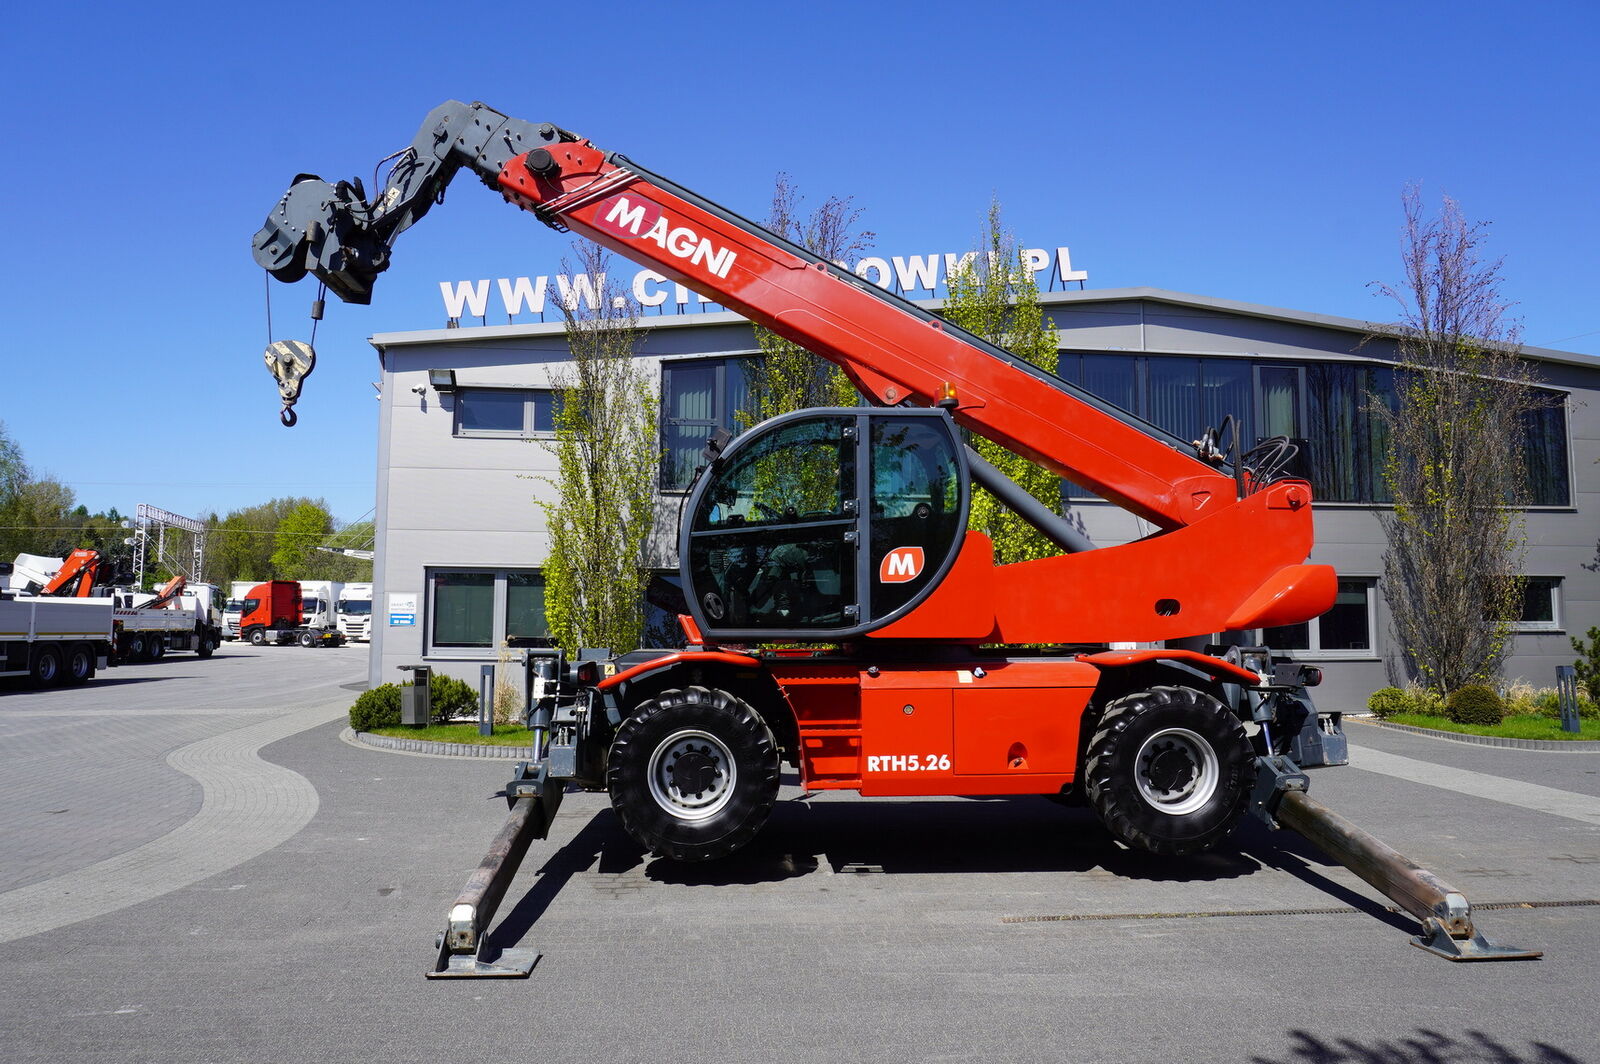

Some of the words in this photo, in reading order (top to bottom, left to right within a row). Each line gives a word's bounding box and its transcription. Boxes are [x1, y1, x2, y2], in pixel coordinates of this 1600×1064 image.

[604, 196, 738, 280] MAGNI
[887, 553, 916, 576] M
[867, 754, 951, 772] RTH5.26
